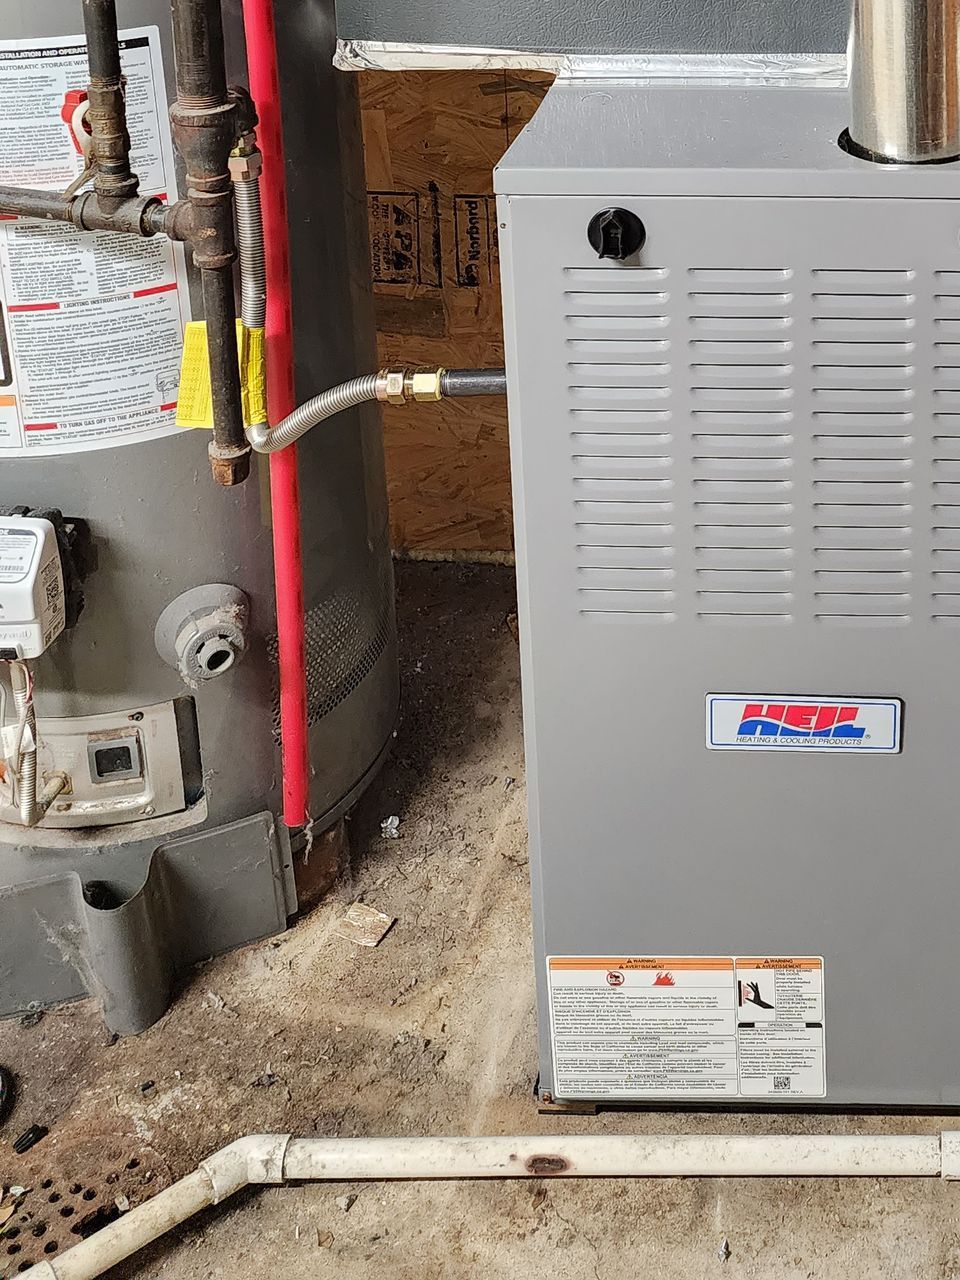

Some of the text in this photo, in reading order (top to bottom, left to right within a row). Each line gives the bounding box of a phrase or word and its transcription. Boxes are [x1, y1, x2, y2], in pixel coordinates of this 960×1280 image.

[40, 60, 73, 69] STORAGE
[464, 200, 480, 261] Norbord
[90, 295, 131, 305] INSTRUCTIONS
[128, 408, 159, 419] APPLIANCE
[736, 704, 866, 738] HEIL
